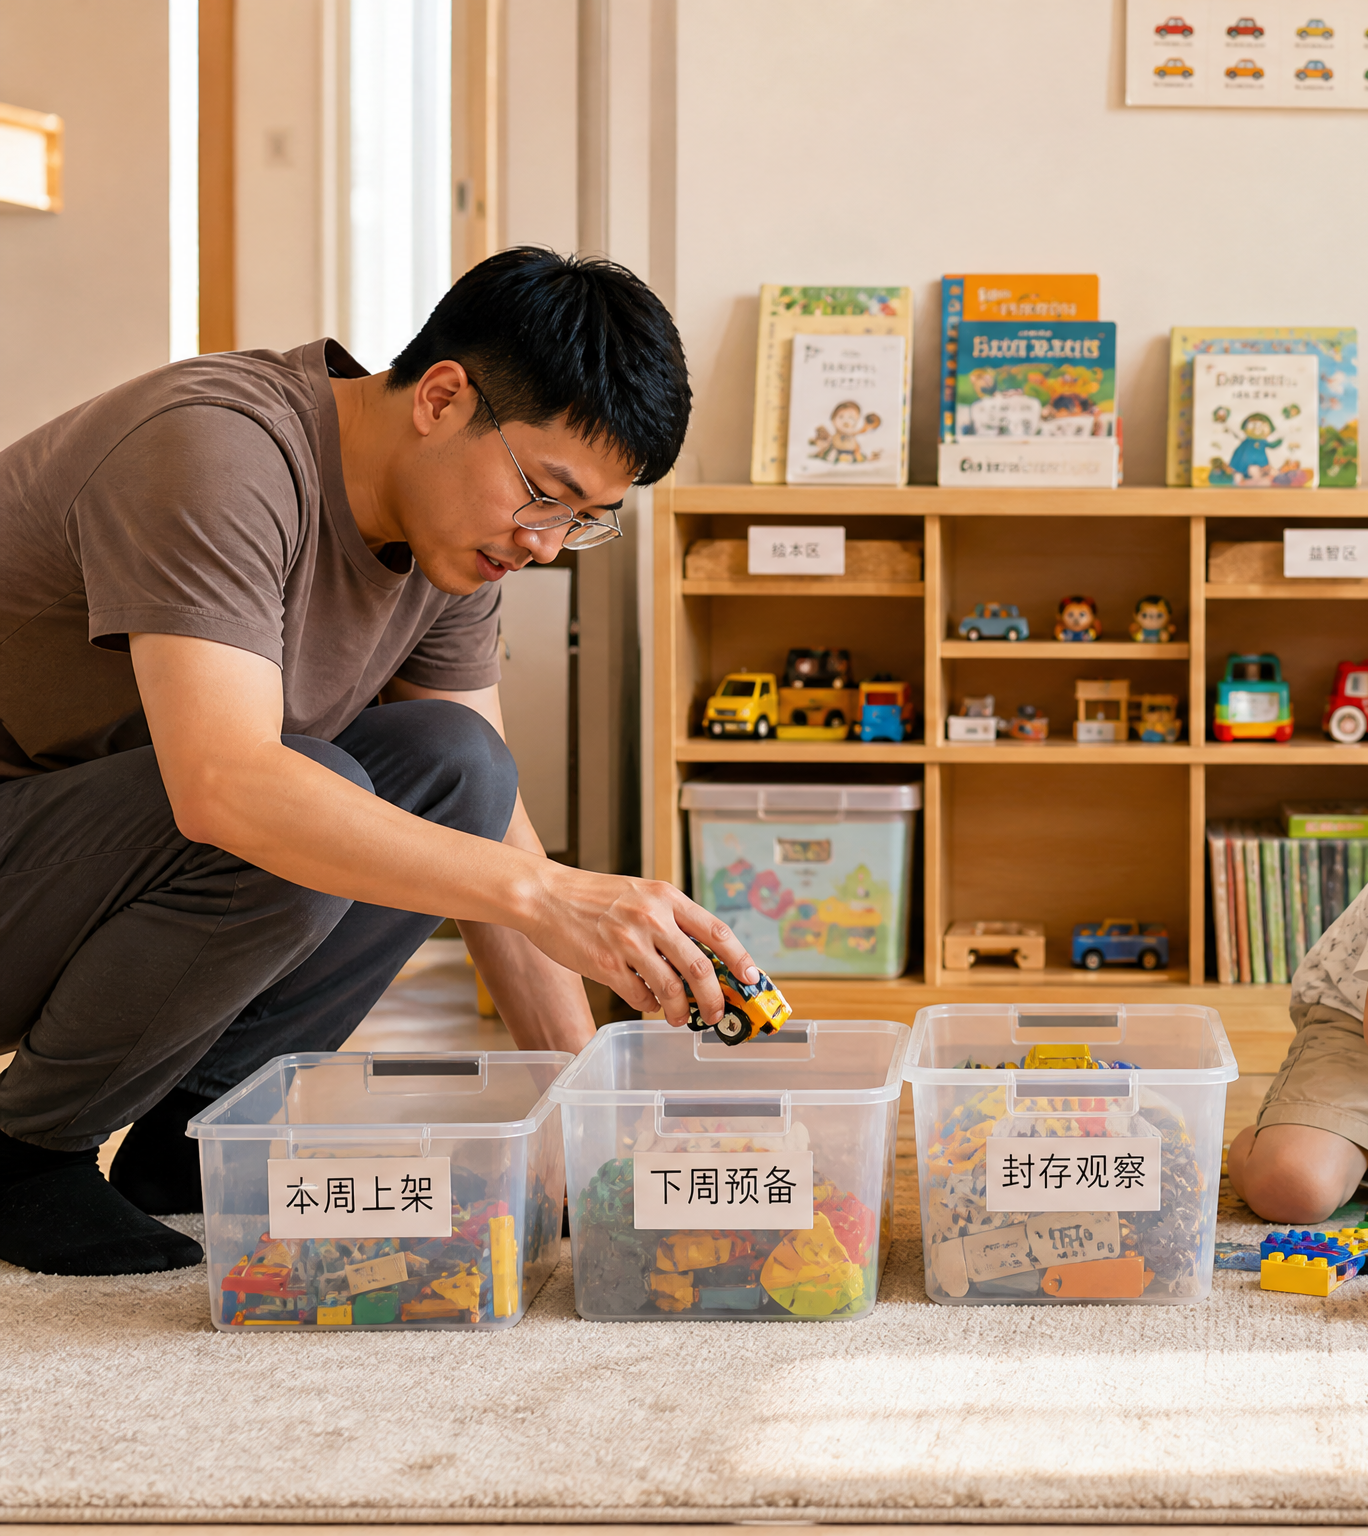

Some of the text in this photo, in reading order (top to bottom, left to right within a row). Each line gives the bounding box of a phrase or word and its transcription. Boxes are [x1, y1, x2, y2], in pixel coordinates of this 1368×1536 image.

[771, 542, 821, 558] 绘本区
[1308, 545, 1357, 562] 益智区
[650, 1165, 798, 1205] 下周预备
[1001, 1152, 1146, 1189] 封存观察
[285, 1173, 434, 1215] 本周上架
